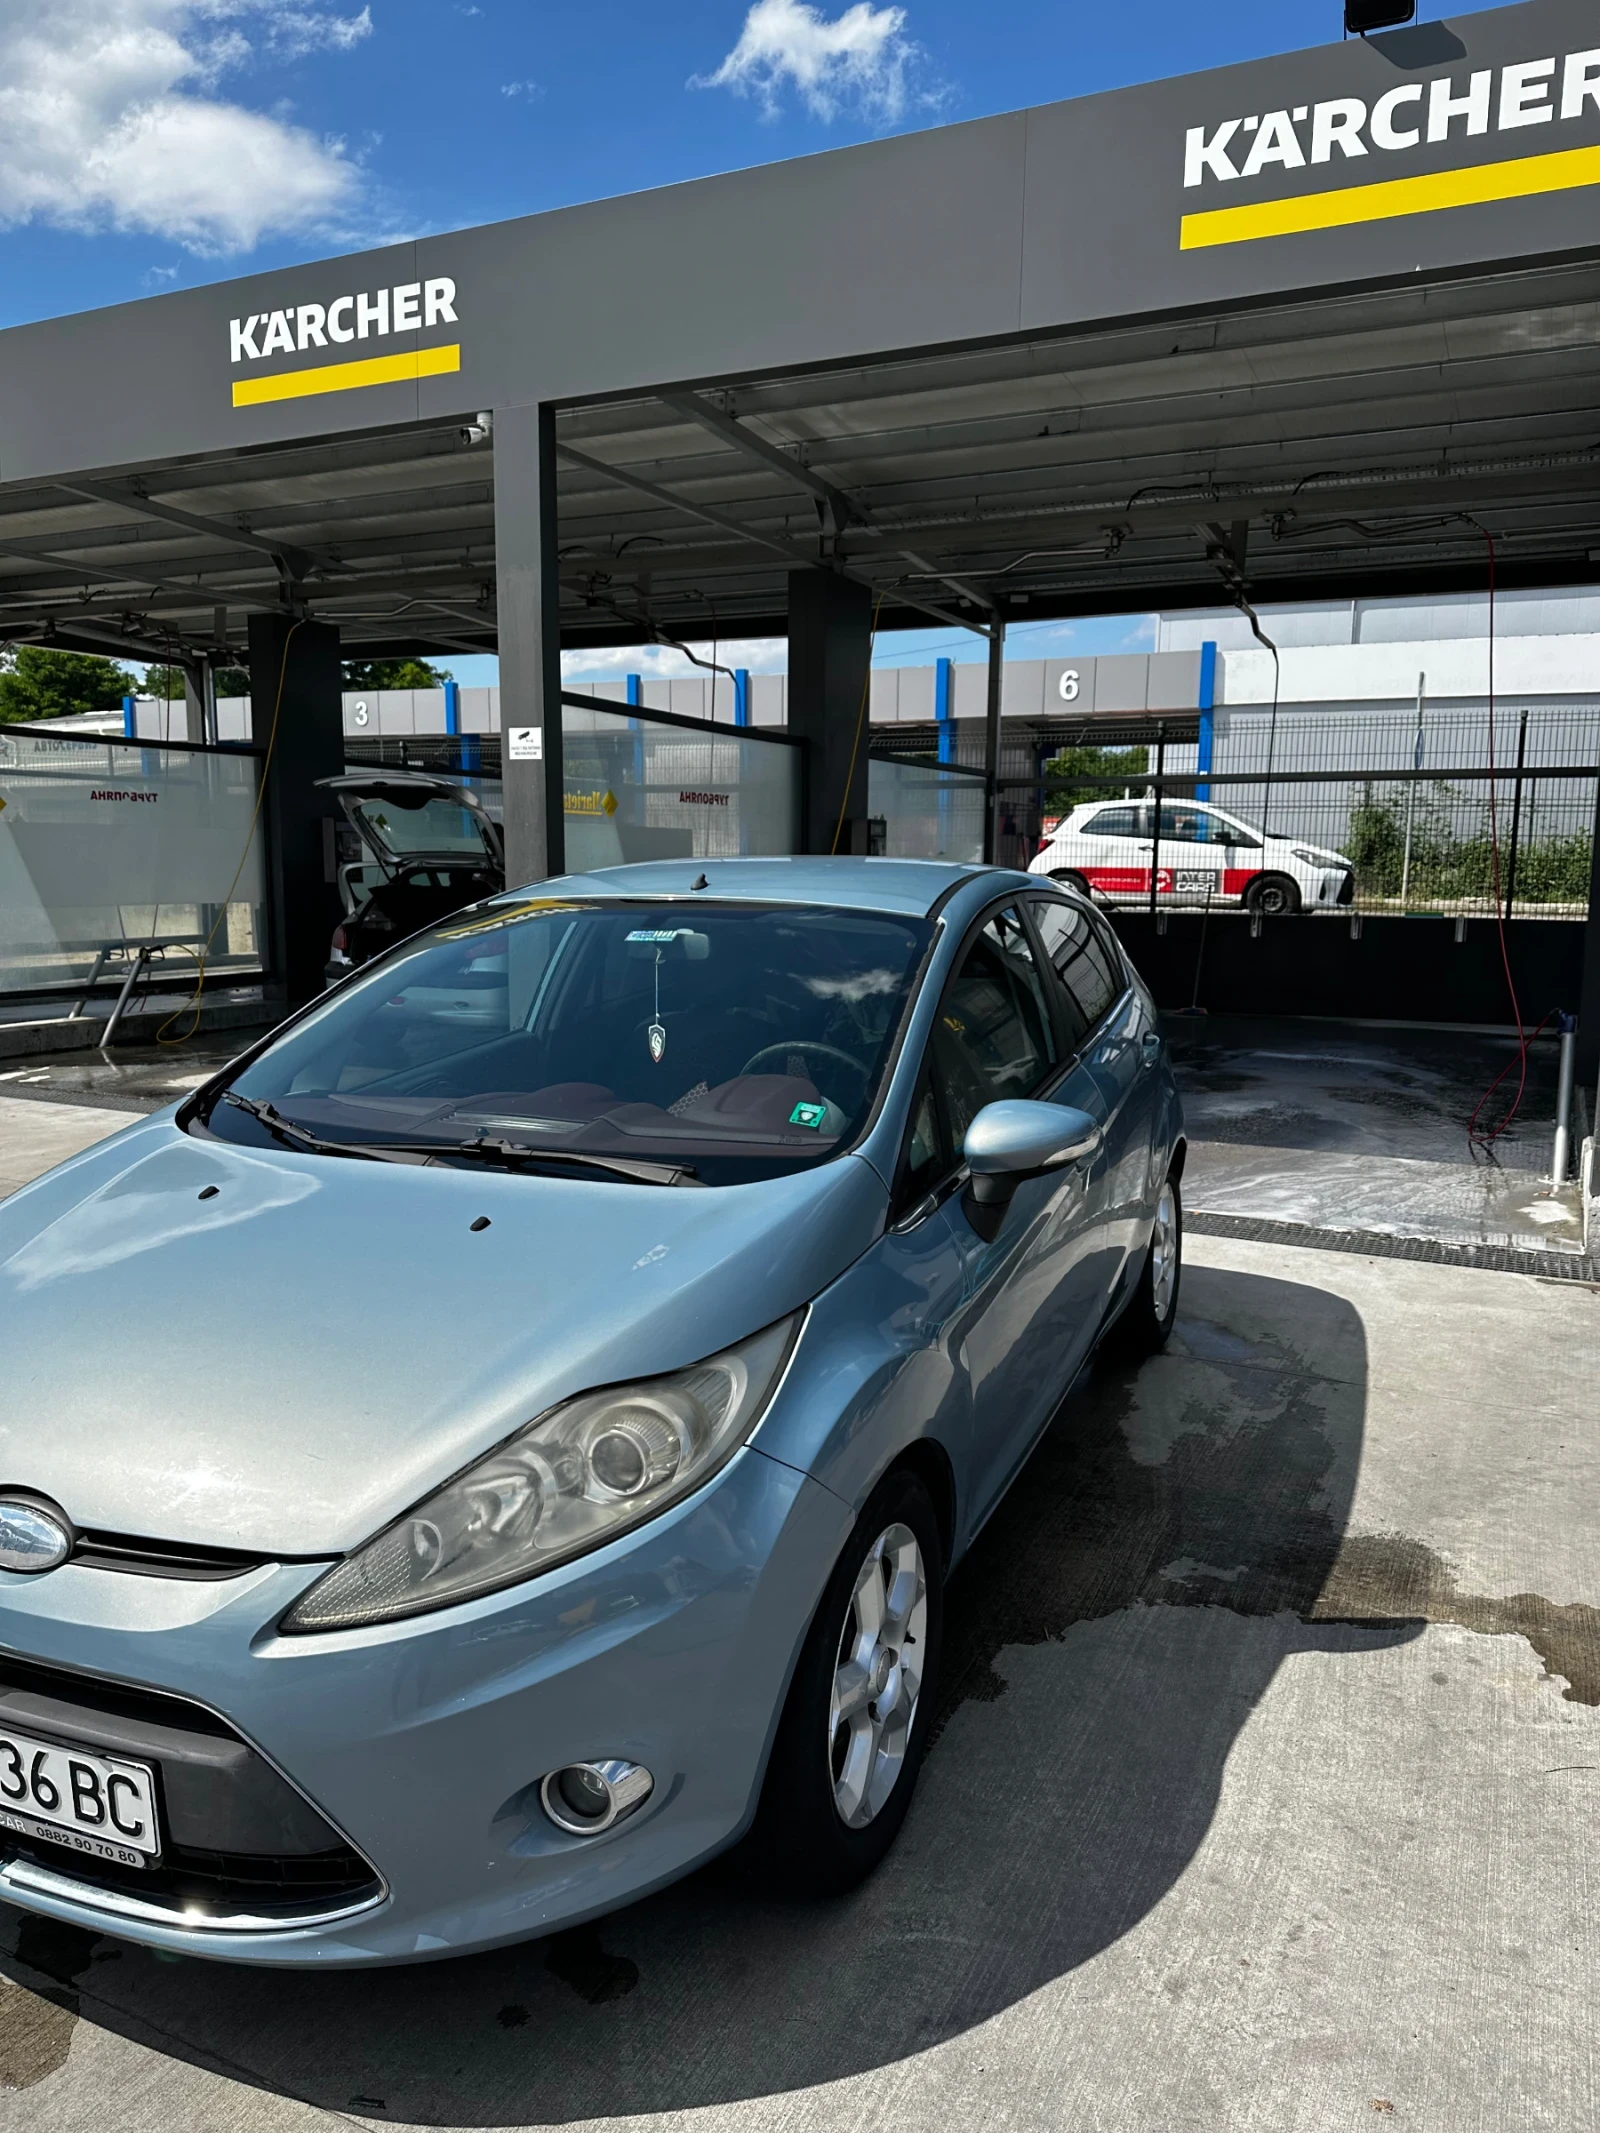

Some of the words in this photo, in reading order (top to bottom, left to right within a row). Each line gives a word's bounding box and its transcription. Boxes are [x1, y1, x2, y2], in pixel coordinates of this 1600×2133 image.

[1183, 47, 1600, 188] KÄRCHER
[229, 277, 459, 363] KÄRCHER
[1058, 669, 1080, 701] 6
[355, 701, 368, 726] 3
[1176, 871, 1216, 881] INTER
[1176, 882, 1215, 892] CARS
[0, 1739, 60, 1810] 36
[36, 1826, 72, 1845] 0882
[74, 1837, 92, 1851] 90
[96, 1843, 114, 1858] 70
[118, 1850, 137, 1864] 80
